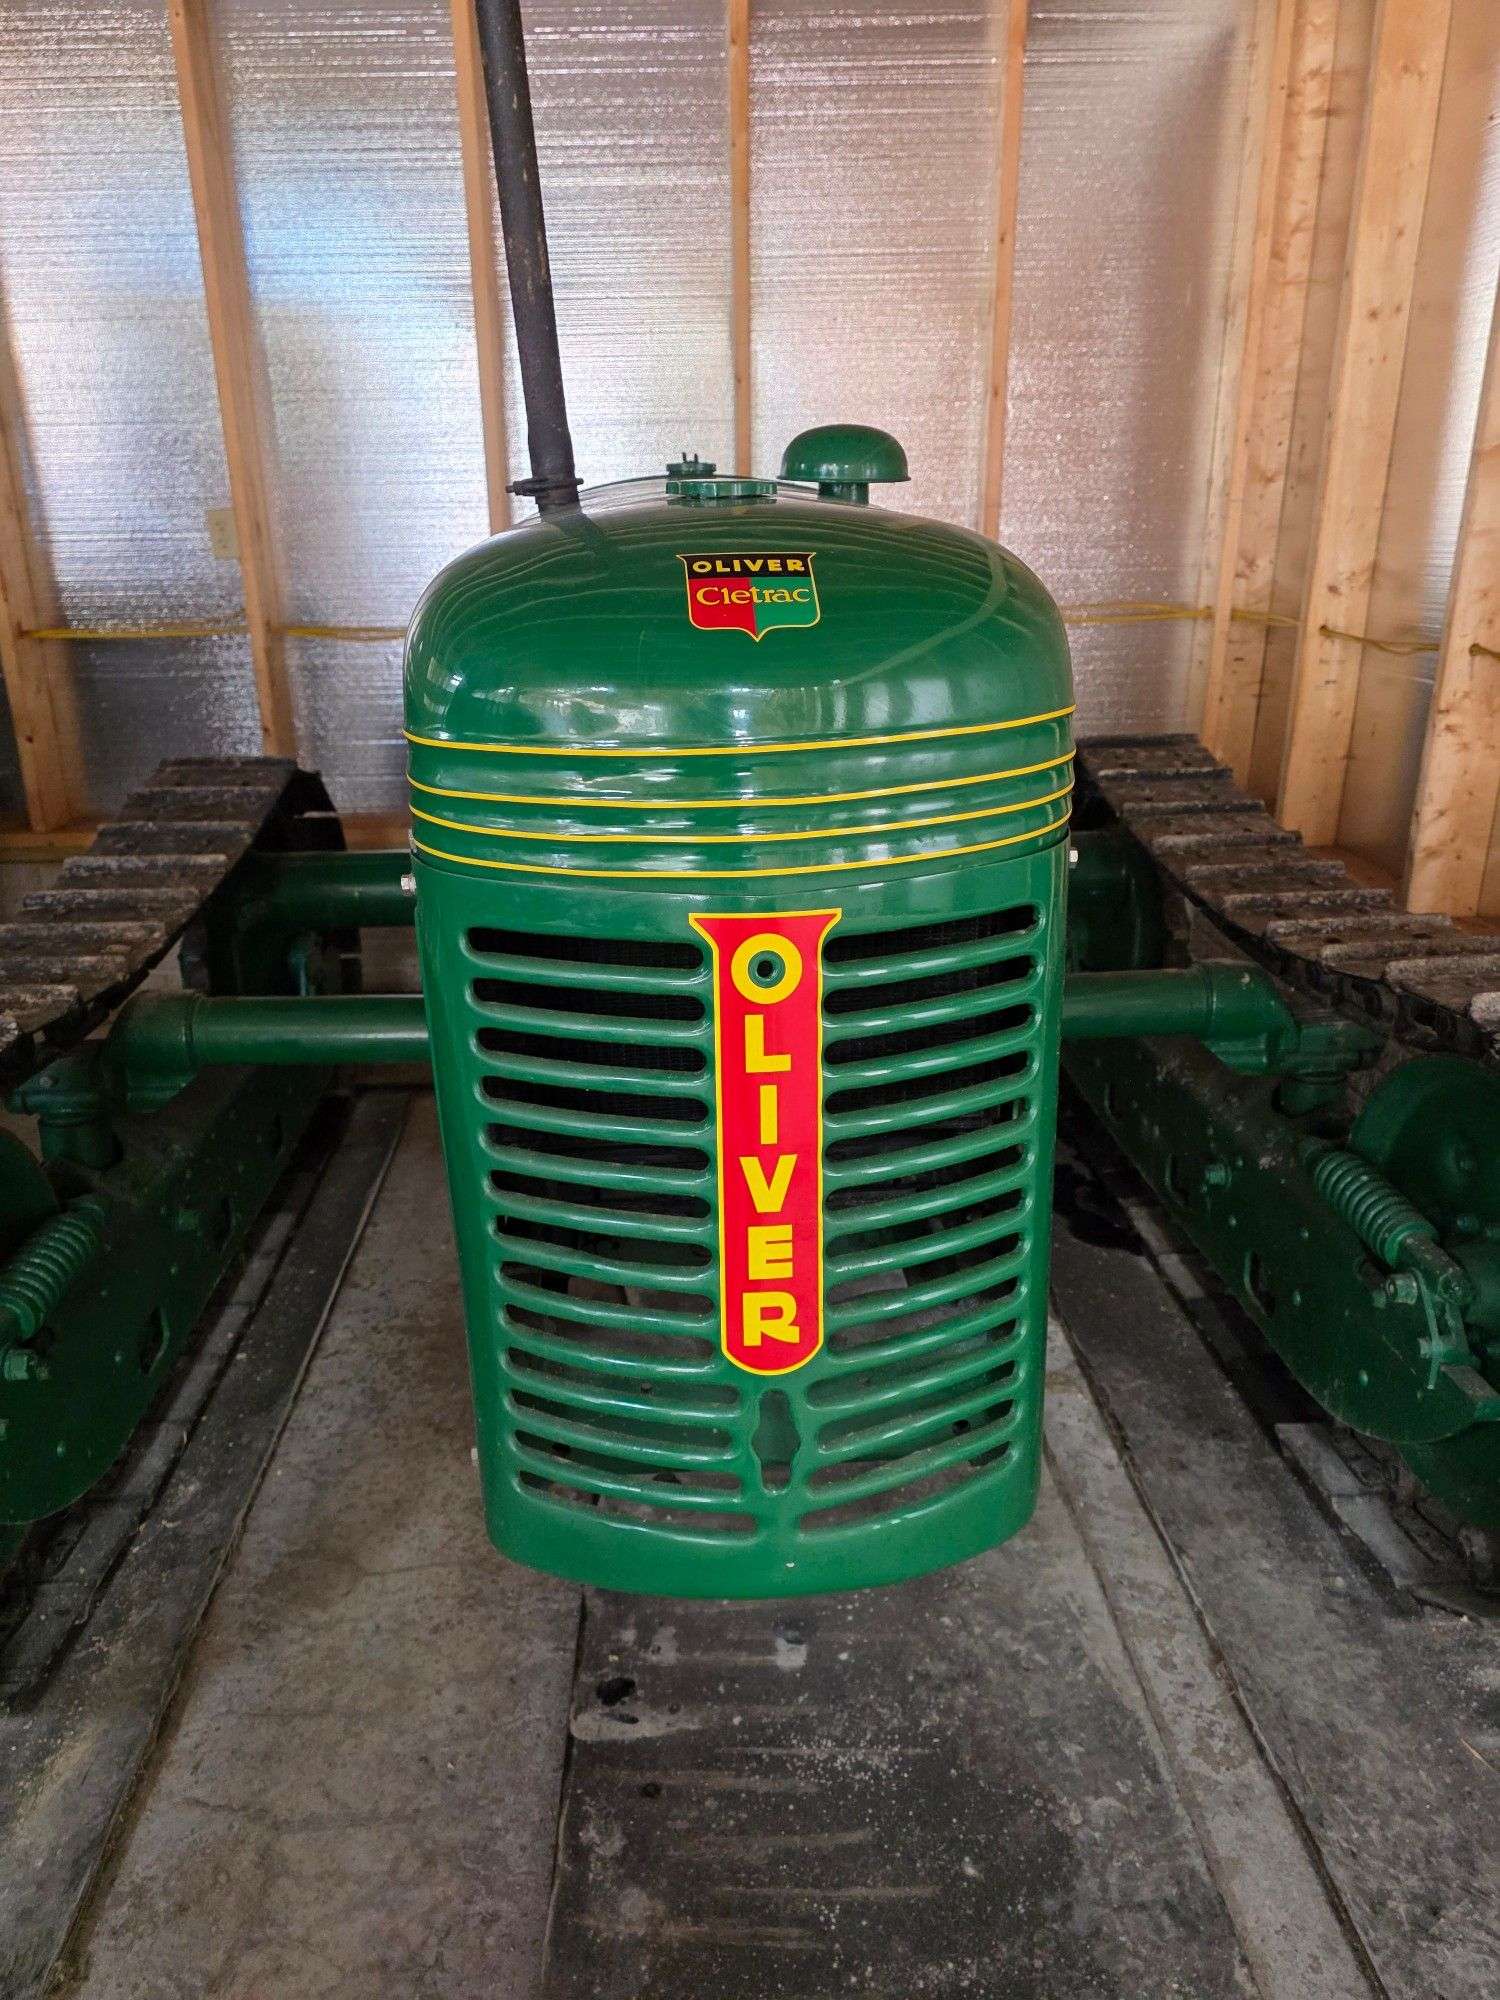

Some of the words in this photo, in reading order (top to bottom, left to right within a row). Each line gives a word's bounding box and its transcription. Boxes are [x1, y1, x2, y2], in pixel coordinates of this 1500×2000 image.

[692, 559, 805, 573] OLIVER
[696, 586, 811, 606] Cletrac
[731, 933, 803, 1347] OLIVER
